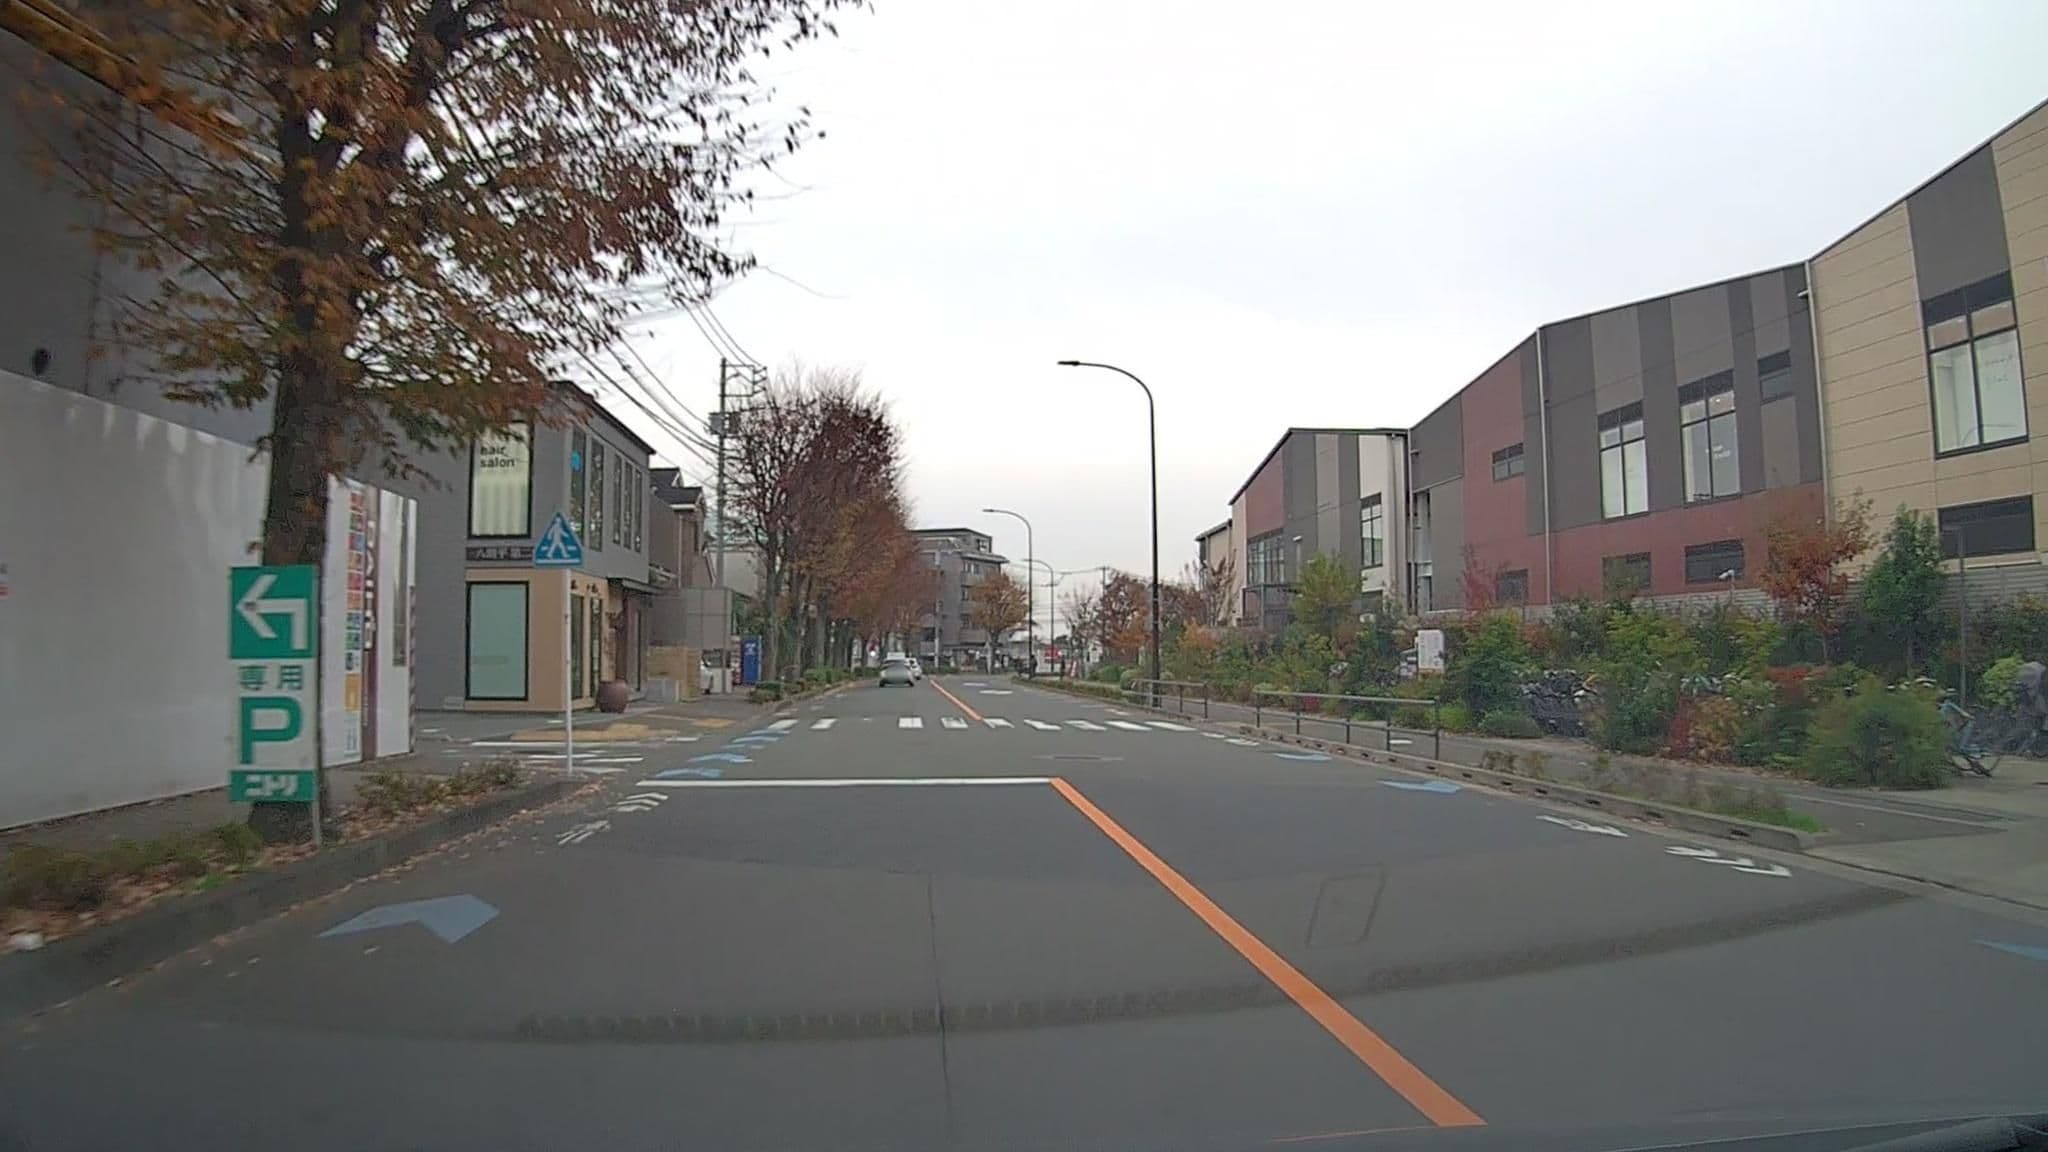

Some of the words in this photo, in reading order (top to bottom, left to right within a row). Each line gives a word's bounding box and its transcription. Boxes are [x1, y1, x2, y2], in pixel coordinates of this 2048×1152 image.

[480, 457, 515, 467] salon
[239, 665, 303, 691] 専用
[240, 696, 302, 764] P
[246, 774, 299, 796] ニトリ
